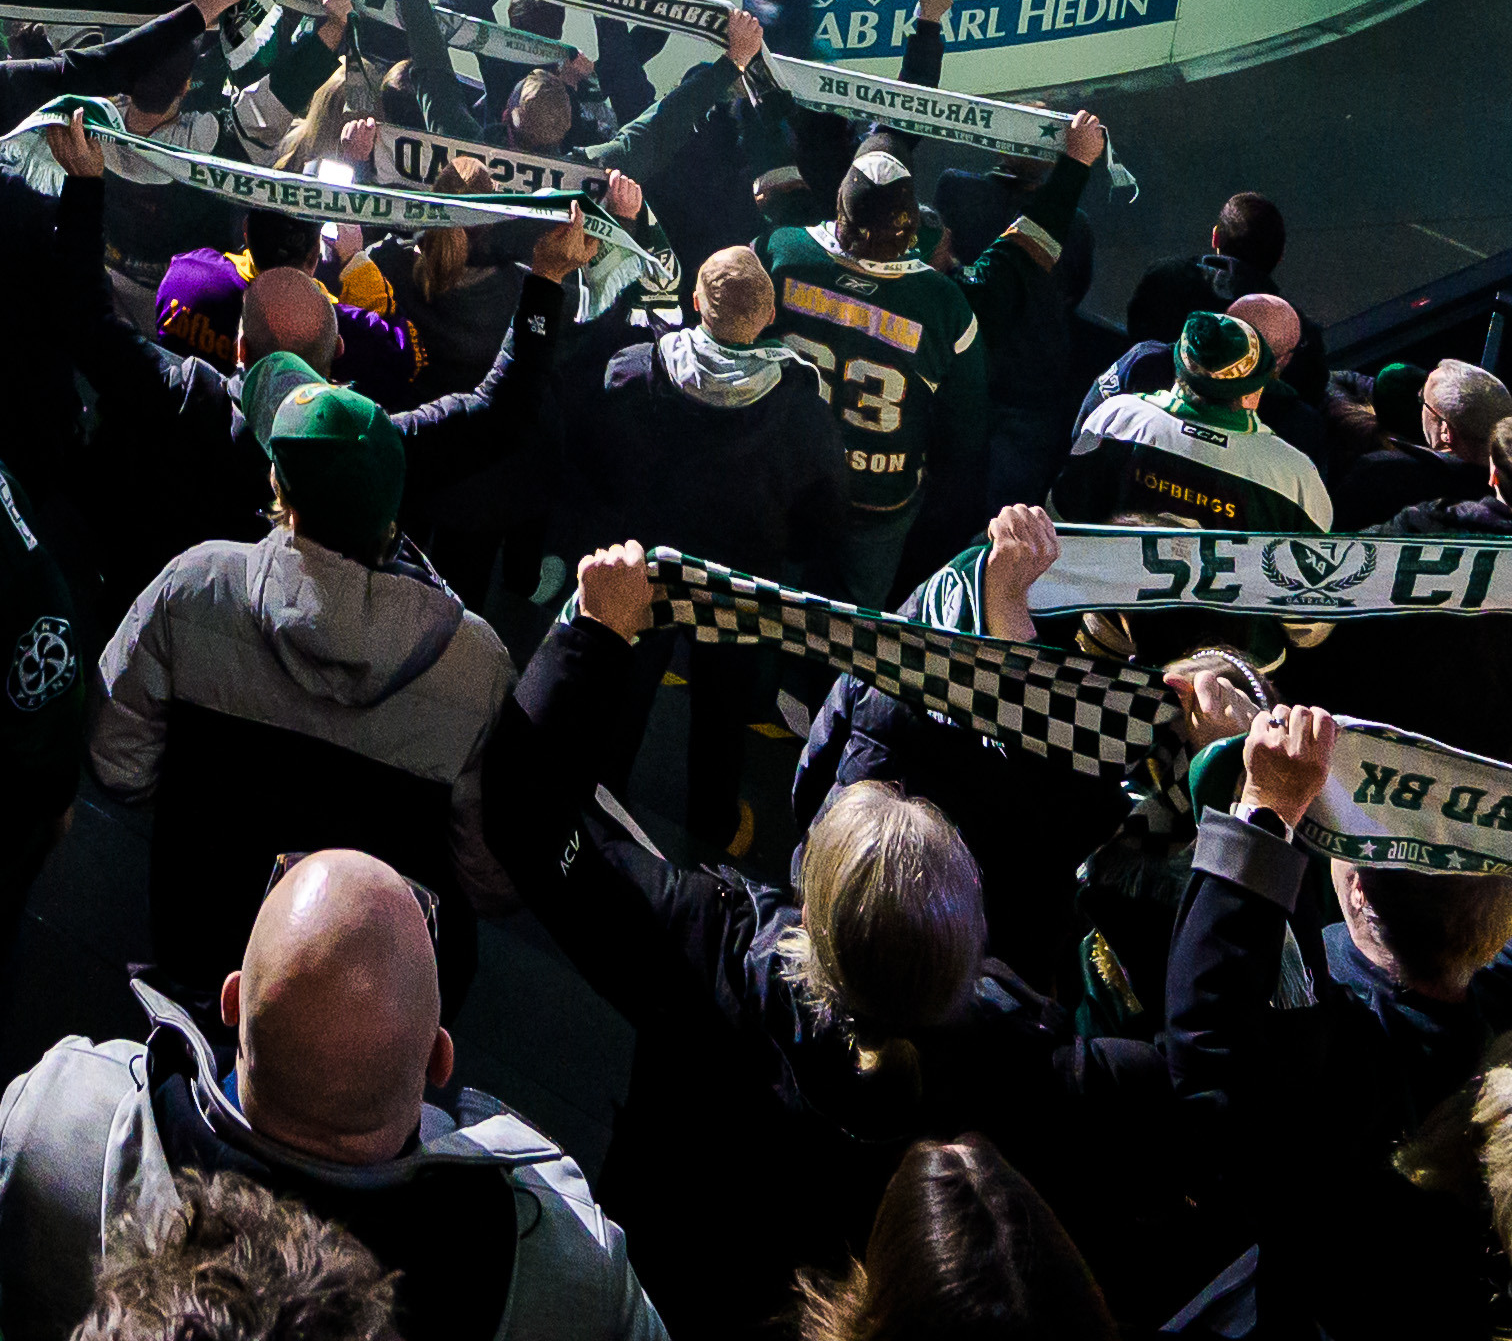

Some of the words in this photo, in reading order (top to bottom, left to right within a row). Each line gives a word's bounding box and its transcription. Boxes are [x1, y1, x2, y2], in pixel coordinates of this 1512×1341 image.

[813, 6, 878, 50] AB
[1180, 422, 1228, 447] CCM
[1133, 467, 1239, 519] LÖFBERGS
